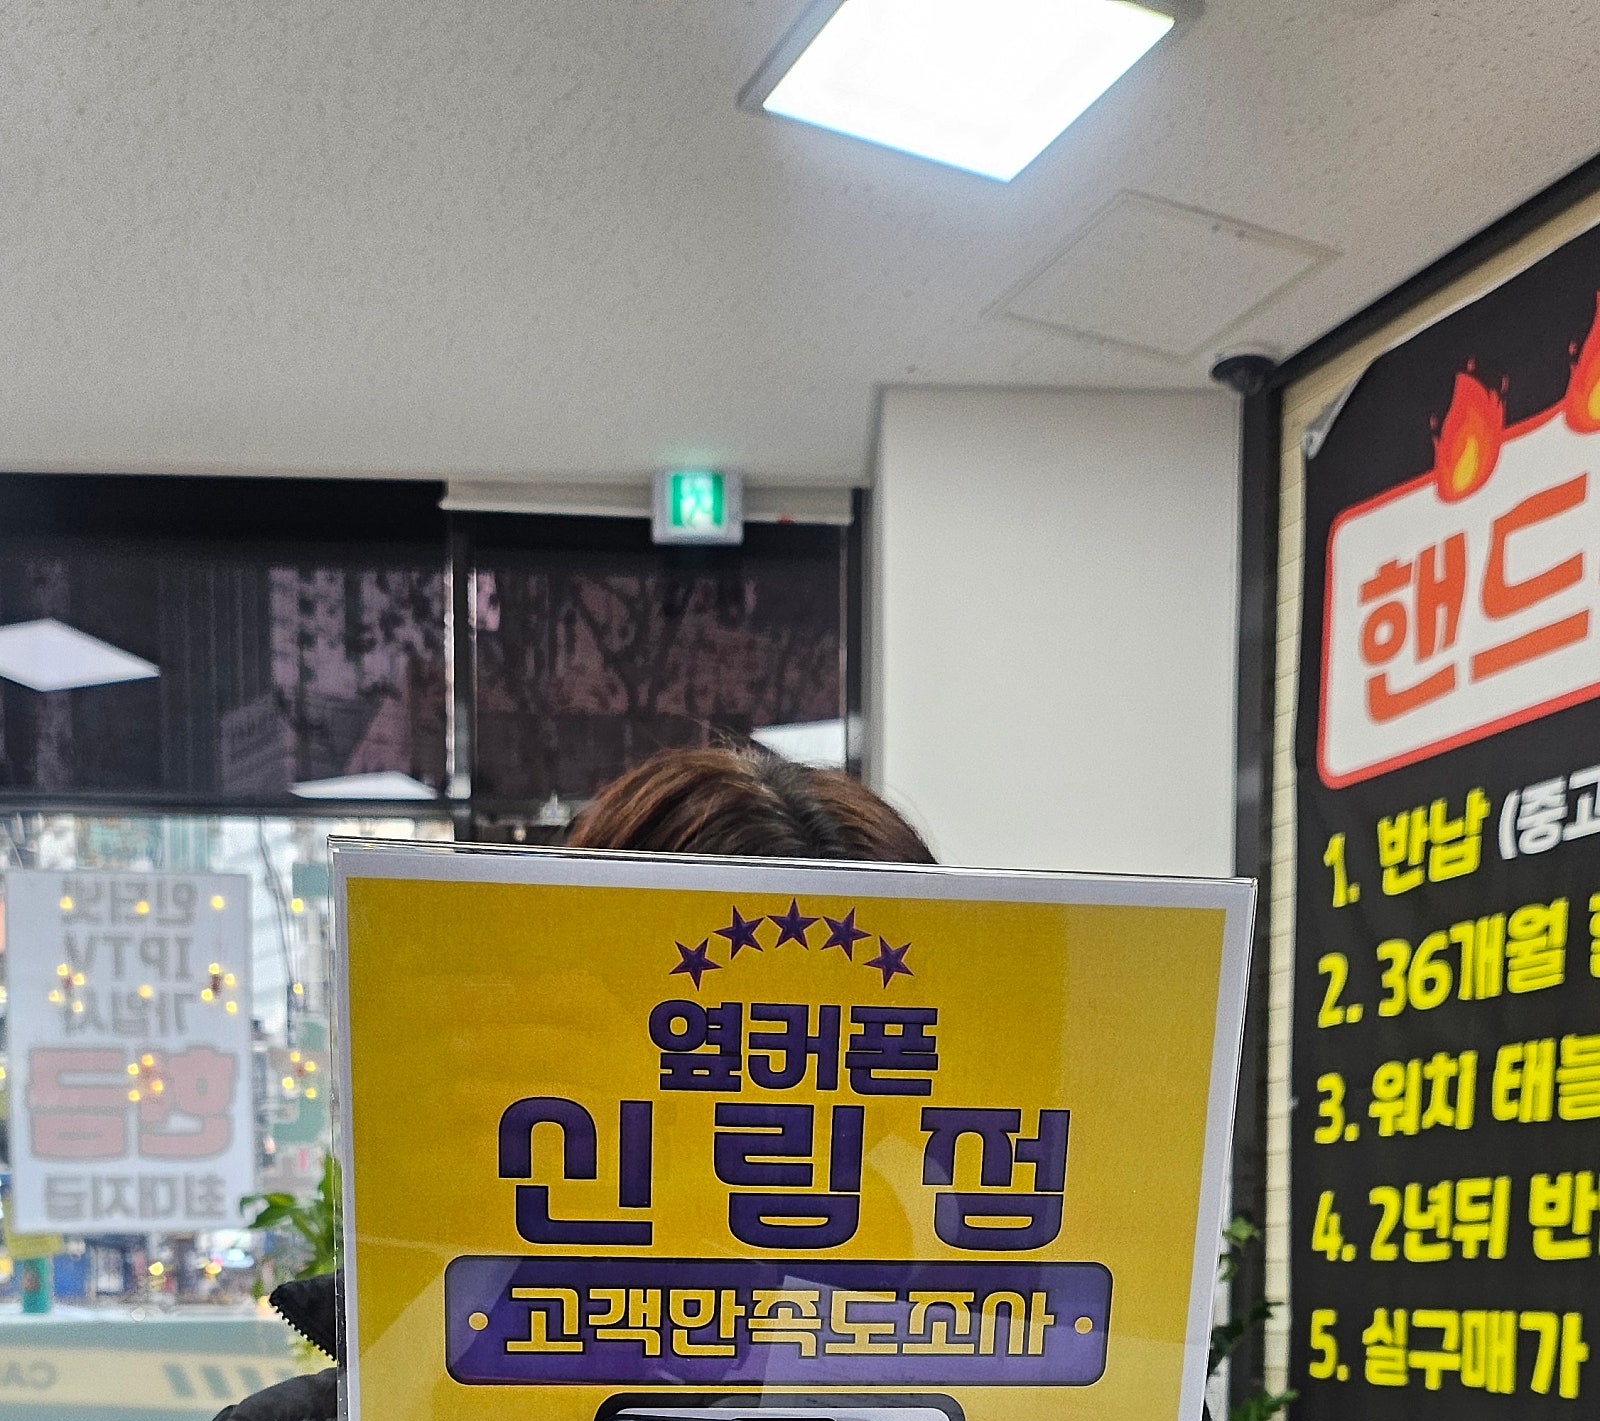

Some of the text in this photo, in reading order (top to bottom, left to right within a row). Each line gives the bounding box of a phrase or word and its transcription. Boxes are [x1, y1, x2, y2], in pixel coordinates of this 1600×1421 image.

[1357, 473, 1589, 725] 핸드
[1323, 832, 1360, 908] 1.
[1377, 787, 1491, 895] 반납
[1318, 952, 1364, 1028] 2.
[1377, 896, 1570, 1017] 36개월
[648, 999, 939, 1096] 옆커폰
[1314, 1072, 1360, 1144] 3.
[1368, 1050, 1478, 1136] 워치
[498, 1096, 1071, 1251] 신림점
[1312, 1191, 1357, 1261] 4.
[1369, 1175, 1511, 1262] 2년뒤
[505, 1286, 1057, 1357] 고객만족도조사
[1309, 1307, 1590, 1399] 5. 실구매가
